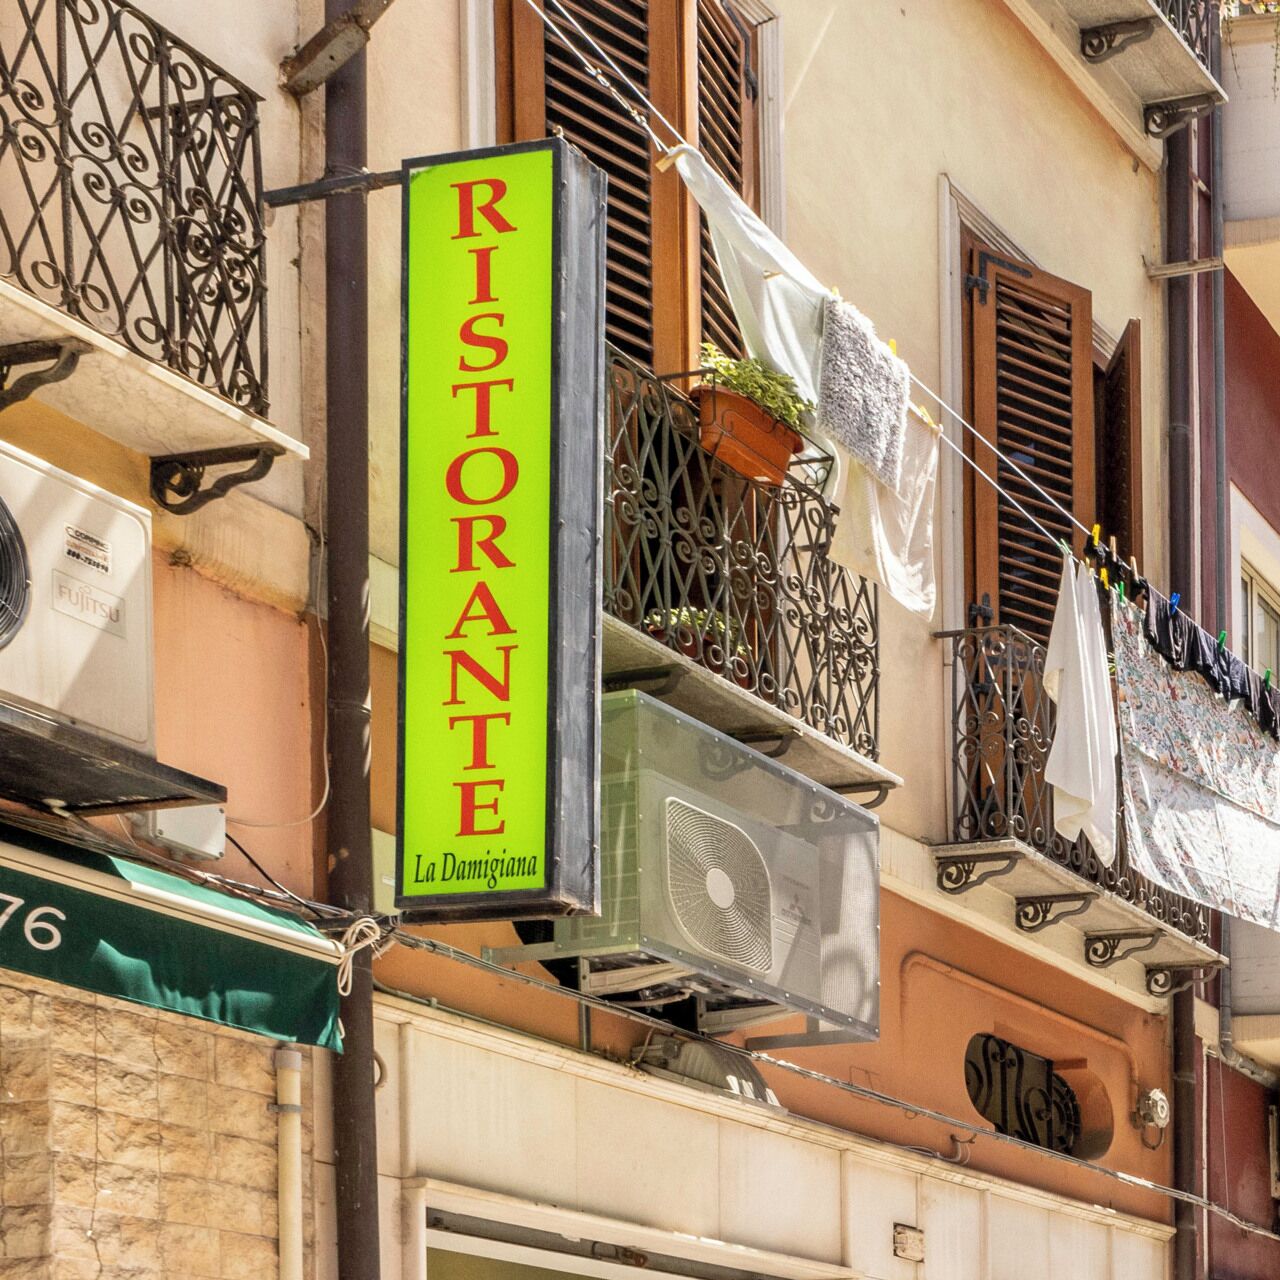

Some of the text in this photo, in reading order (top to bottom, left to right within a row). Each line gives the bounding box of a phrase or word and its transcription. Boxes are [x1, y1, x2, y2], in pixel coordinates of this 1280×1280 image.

[442, 177, 519, 837] RISTORANTE
[58, 584, 120, 623] FUJITSU
[414, 848, 538, 889] La Damigiana
